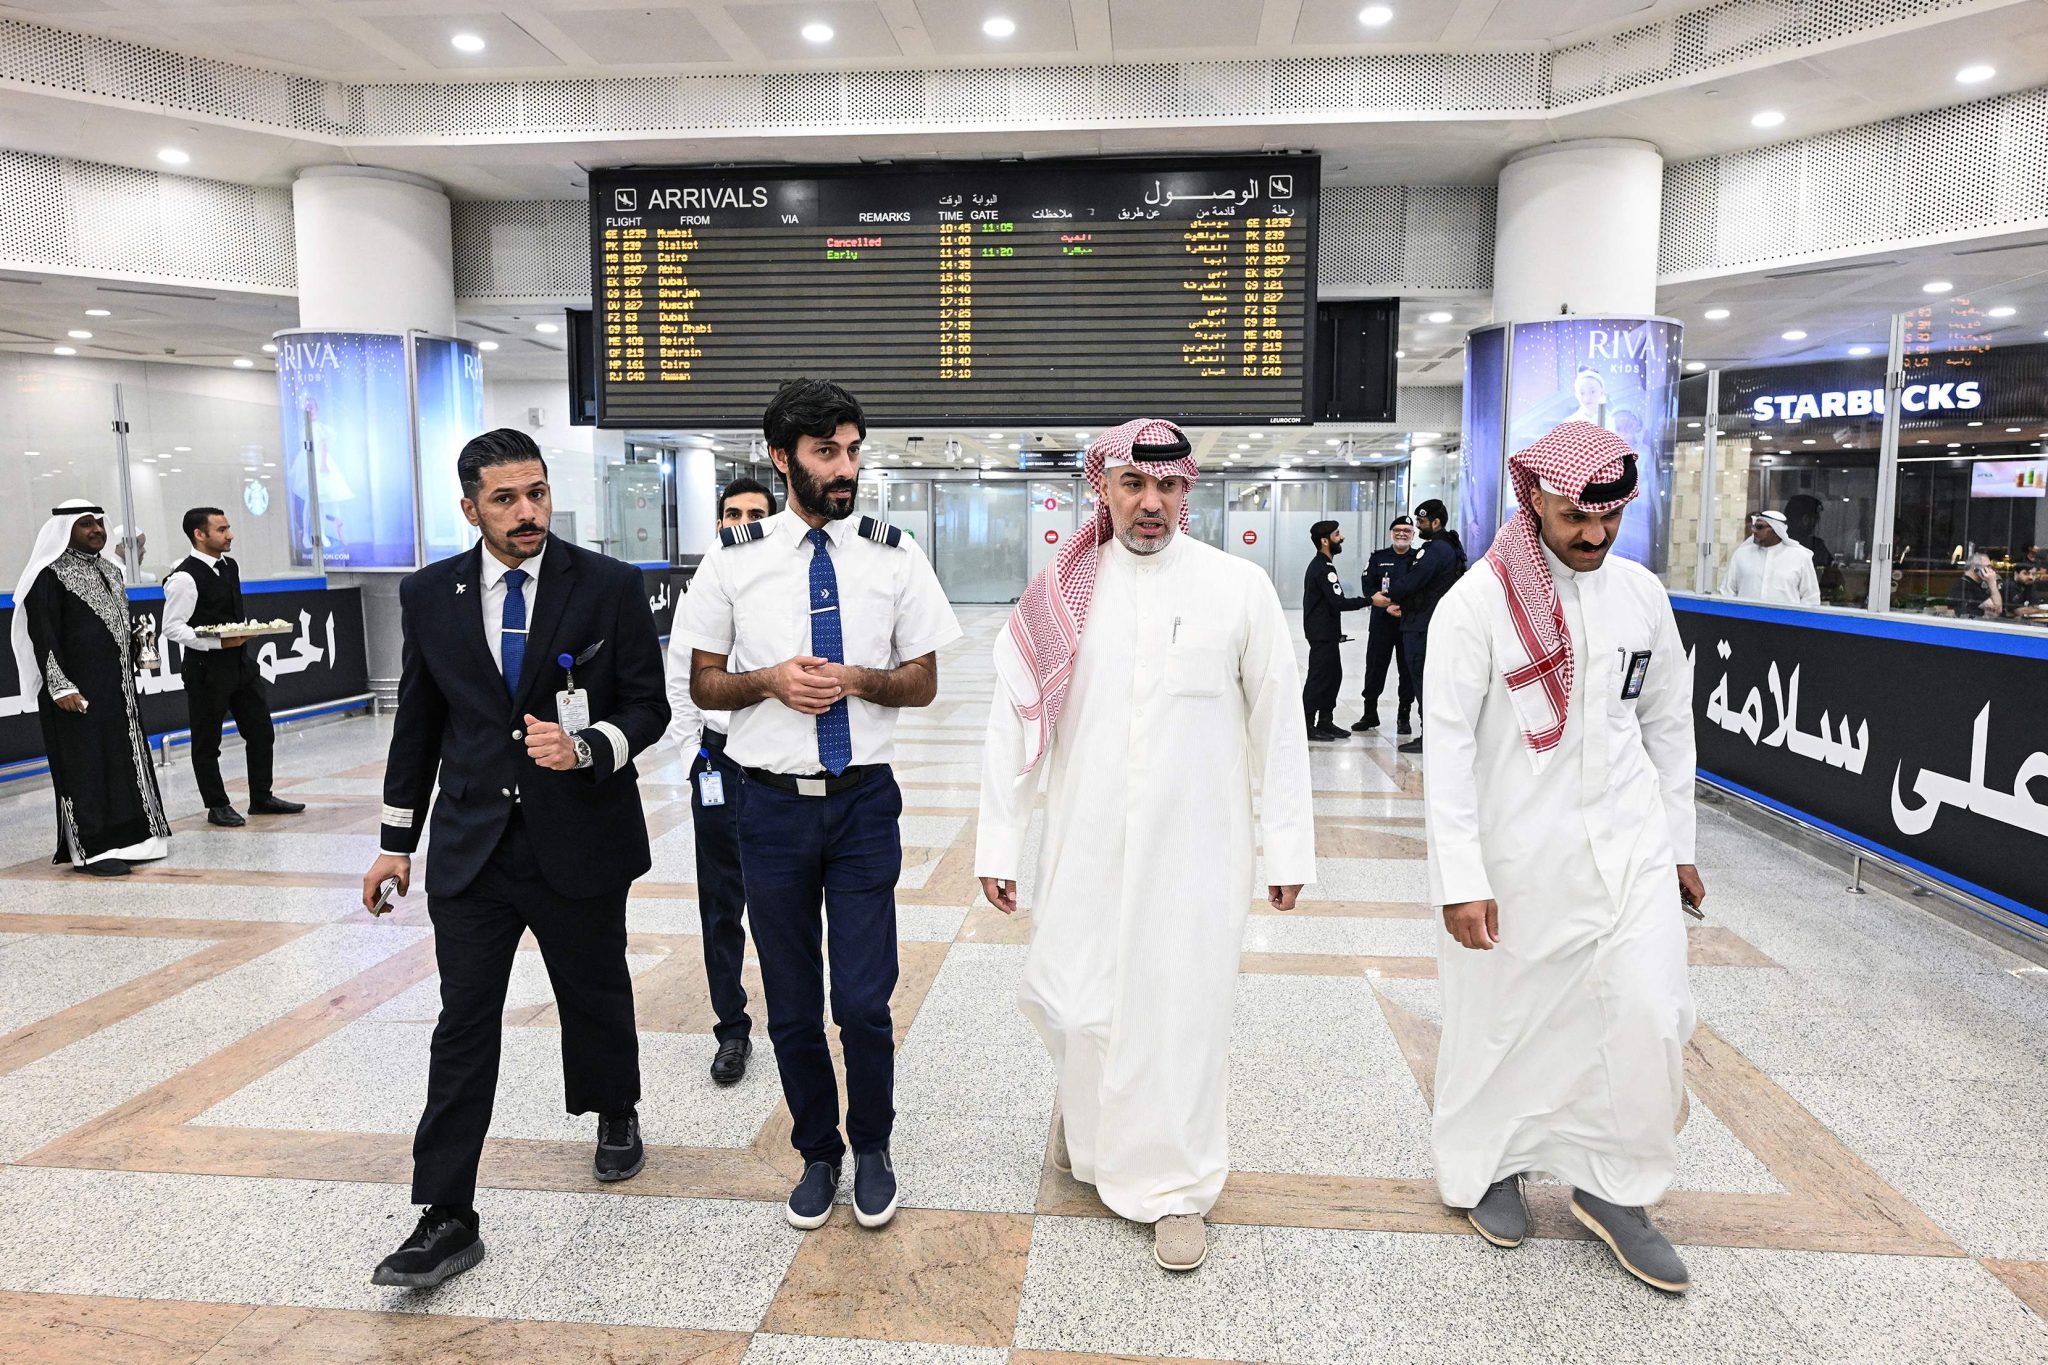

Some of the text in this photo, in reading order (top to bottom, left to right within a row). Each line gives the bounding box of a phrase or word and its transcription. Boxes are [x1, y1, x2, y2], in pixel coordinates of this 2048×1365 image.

[648, 187, 768, 210] ARRIVALS
[939, 195, 963, 208] الوقت
[973, 194, 998, 208] البوابة
[970, 210, 999, 221] GATE
[1032, 208, 1073, 219] ملاحظات
[1117, 207, 1161, 220] عن طريق
[1196, 206, 1236, 219] قادمة من
[1272, 204, 1295, 217] رحلة
[606, 216, 642, 227] FLIGHT
[680, 215, 711, 226] FROM
[781, 214, 800, 224] VIA
[859, 212, 911, 223] REMARKS
[937, 211, 964, 222] TIME
[982, 223, 1014, 232] 11:05
[1265, 218, 1292, 228] 1235
[940, 224, 972, 233] 10:45
[623, 229, 647, 239] 1235
[657, 229, 692, 238] Mumbai
[1246, 231, 1285, 240] PK 239
[827, 238, 882, 247] Cancelled
[940, 236, 972, 245] 11:00
[606, 241, 698, 251] PK 239 Sialkot
[1246, 243, 1285, 253] MS 610
[827, 251, 858, 260] Early
[940, 248, 972, 257] 11:45
[983, 247, 1014, 257] 11:20
[606, 253, 688, 263] MS 610 Cairo
[1264, 256, 1290, 265] 2957
[940, 260, 972, 269] 14:35
[624, 265, 648, 275] 2957
[658, 265, 682, 274] Abha
[1245, 268, 1284, 278] EK 857
[607, 277, 688, 287] EK 857 Dubai
[940, 273, 972, 282] 15:45
[940, 285, 972, 294] 16:40
[1264, 281, 1283, 290] 121
[624, 289, 642, 298] 121
[659, 289, 700, 299] Sharjah
[1264, 293, 1283, 302] 227
[625, 301, 643, 310] 227
[659, 301, 693, 310] Muscat
[940, 297, 972, 306] 17:15
[940, 309, 972, 318] 17:25
[1245, 305, 1276, 315] FZ 63
[608, 313, 688, 322] FZ 63 Dubai
[1244, 318, 1276, 327] G9 22
[608, 324, 712, 334] G9 22 Abu Dhabi
[940, 321, 972, 330] 17:55
[940, 333, 972, 342] 17:55
[1244, 330, 1282, 339] ME 408
[609, 336, 694, 346] ME 408 Beirut
[1588, 330, 1657, 360] RIVA
[940, 345, 972, 354] 18:00
[1244, 342, 1282, 352] GF 215
[284, 342, 340, 369] RIVA
[609, 348, 701, 357] GF 215 Bahrain
[627, 360, 644, 369] 161
[661, 360, 690, 369] Cairo
[940, 357, 972, 366] 18:40
[1262, 355, 1281, 364] 161
[1243, 367, 1256, 376] RJ
[1610, 363, 1640, 374] KIDS
[299, 374, 322, 382] KIDS
[610, 372, 622, 381] RJ
[661, 372, 690, 381] Amman
[940, 370, 972, 379] 19:10
[1706, 639, 1869, 775] سلامة
